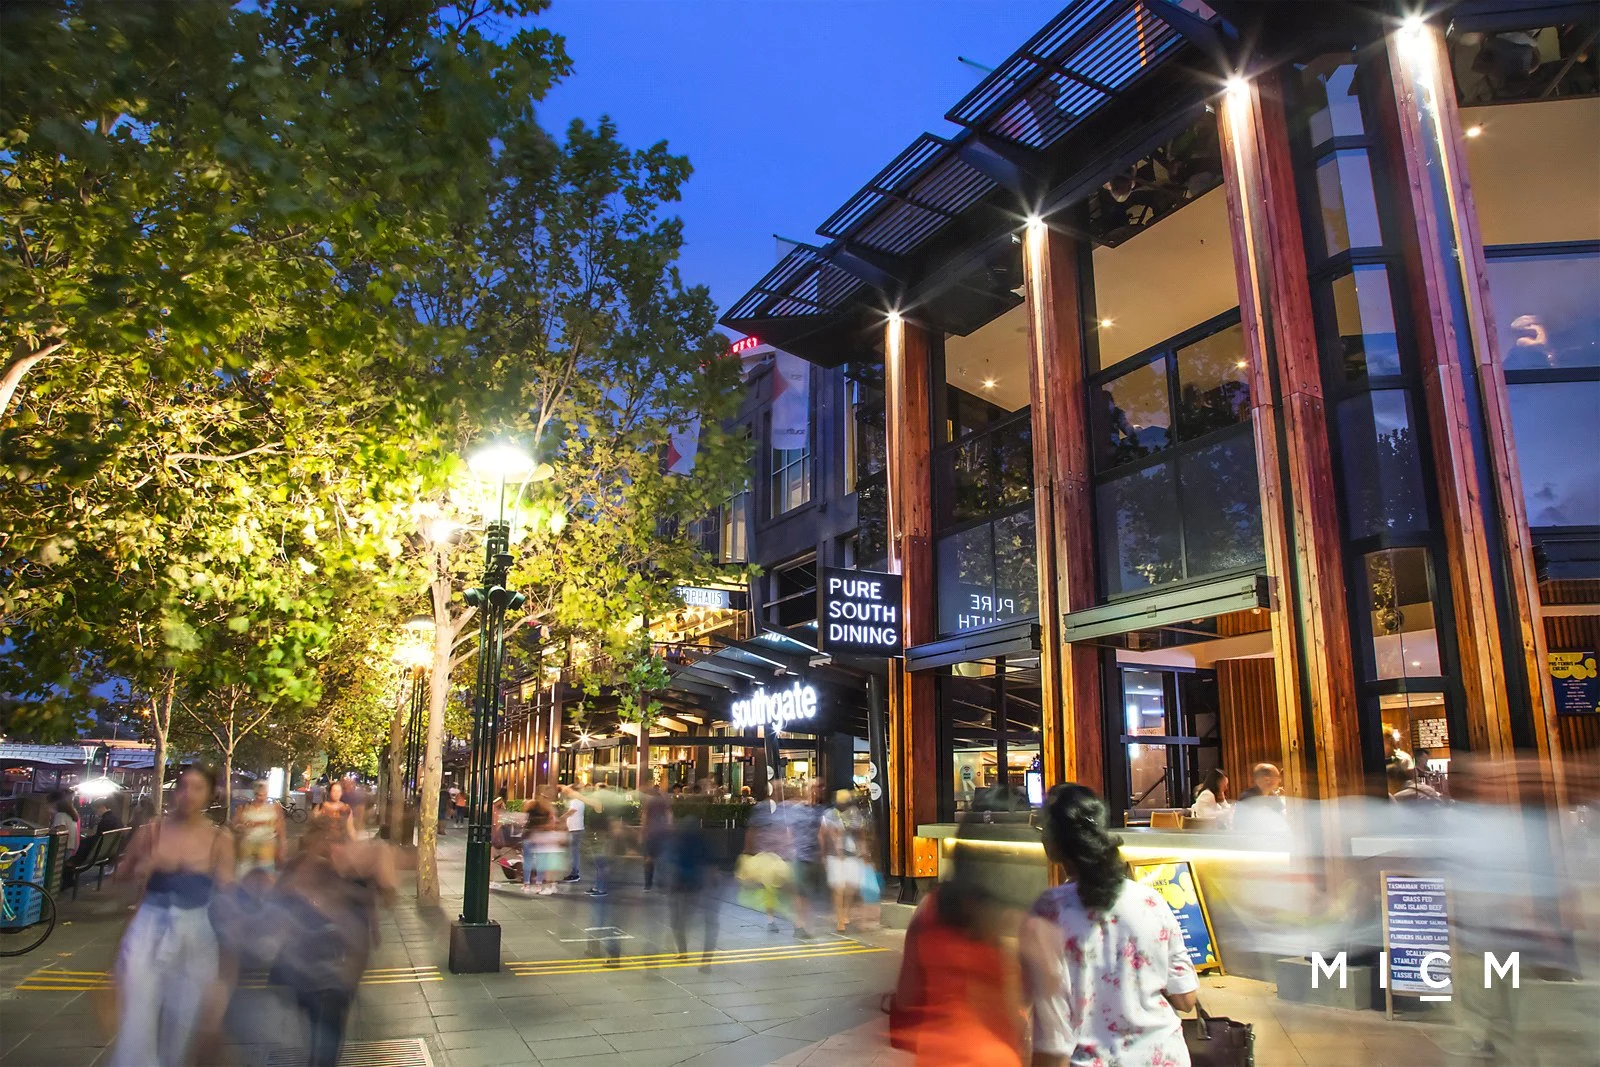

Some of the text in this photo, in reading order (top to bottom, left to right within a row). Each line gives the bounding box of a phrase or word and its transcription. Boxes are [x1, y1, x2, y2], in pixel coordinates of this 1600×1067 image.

[829, 577, 883, 601] PURE
[828, 600, 897, 624] SOUTH
[829, 624, 898, 646] DINING
[731, 681, 818, 731] southgate
[1407, 903, 1428, 911] ISLAND
[1393, 957, 1418, 965] STANLEY
